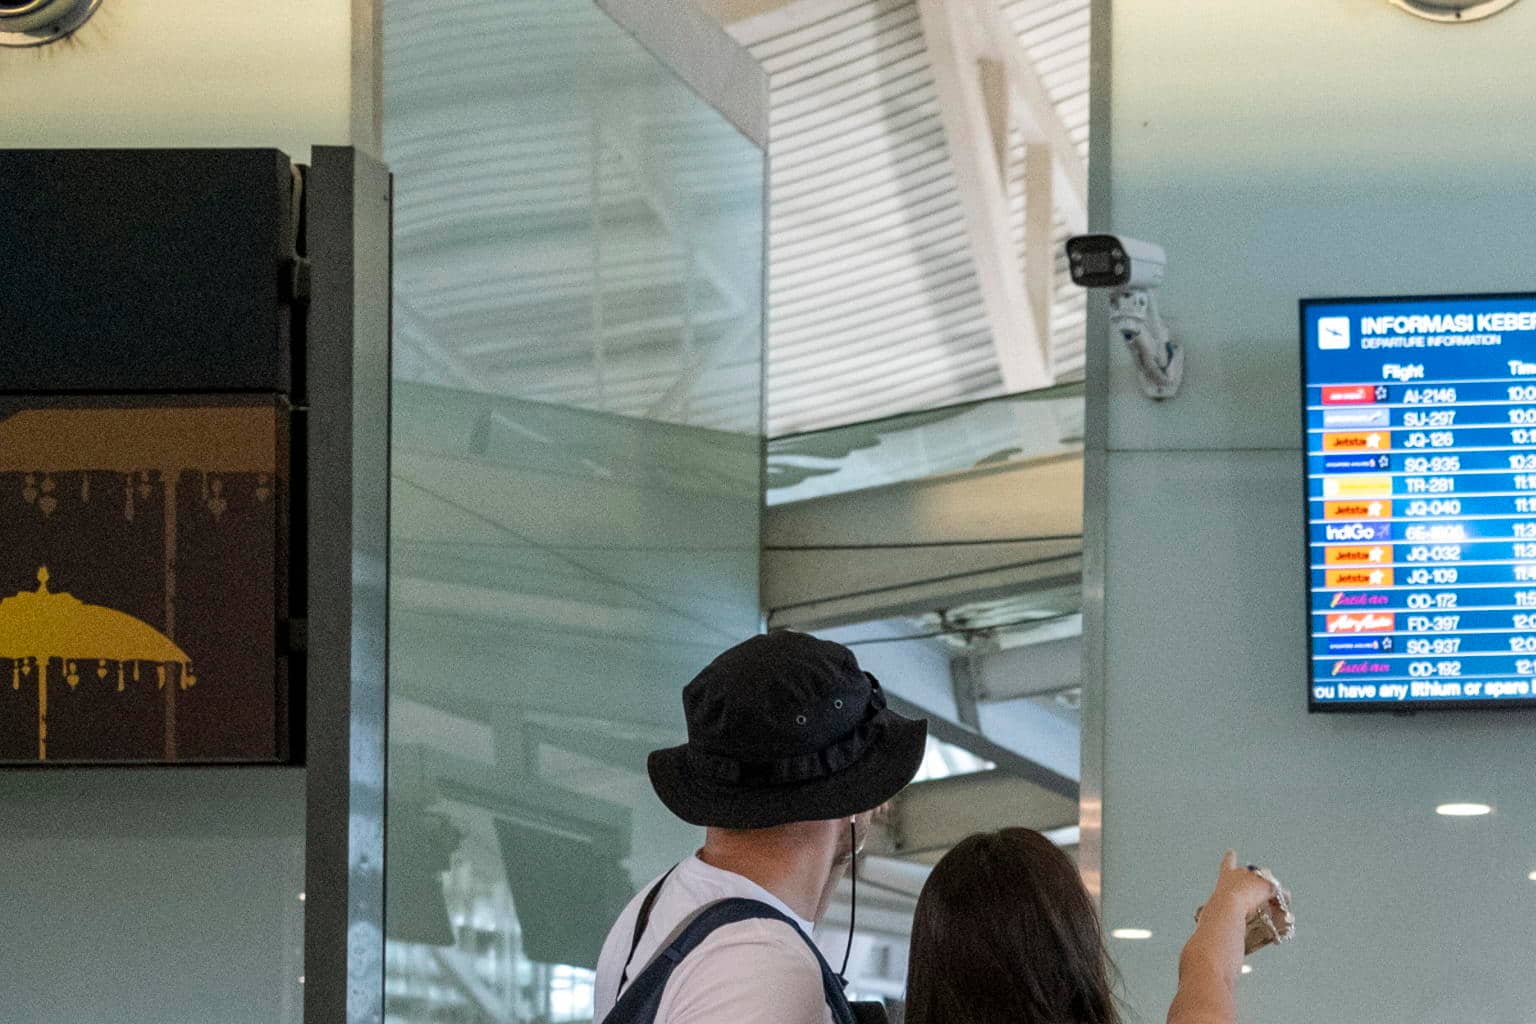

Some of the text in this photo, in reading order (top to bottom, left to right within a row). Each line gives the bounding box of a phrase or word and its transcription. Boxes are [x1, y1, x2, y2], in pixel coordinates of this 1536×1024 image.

[1361, 314, 1473, 334] INFORMASI
[1361, 335, 1501, 349] DEPARTURE INFORMATION
[1383, 364, 1424, 382] Flight
[1326, 525, 1374, 540] IndiGo
[1338, 683, 1375, 698] have
[1379, 685, 1408, 700] any
[1411, 682, 1460, 697] lithium
[1464, 683, 1482, 696] or
[1484, 679, 1529, 698] spare
